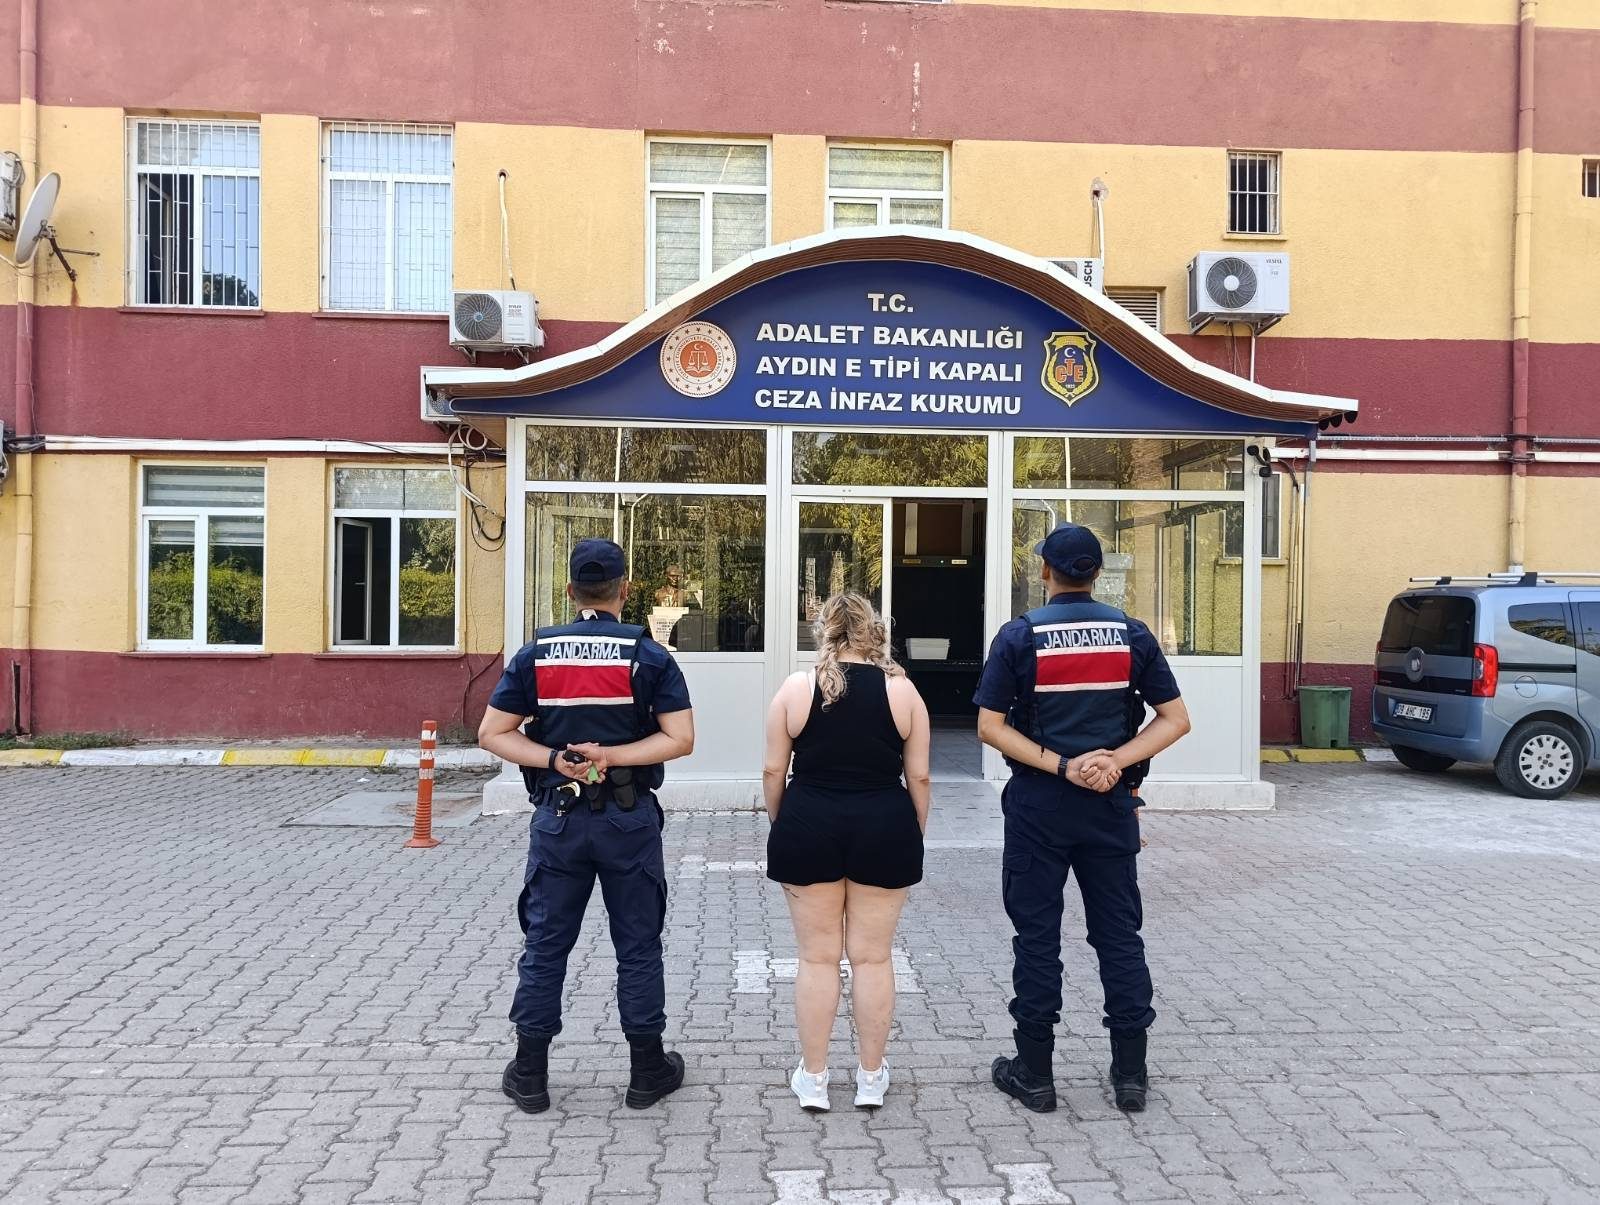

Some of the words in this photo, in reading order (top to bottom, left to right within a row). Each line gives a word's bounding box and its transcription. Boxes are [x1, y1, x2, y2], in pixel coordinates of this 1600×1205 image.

[867, 293, 914, 312] T.C.
[756, 323, 864, 344] ADALET
[873, 326, 1023, 349] BAKANLIĞI
[756, 356, 837, 377] AYDIN
[845, 359, 861, 377] E
[870, 355, 920, 379] TİPİ
[929, 361, 1022, 382] KAPALI
[755, 389, 822, 409] CEZA
[830, 387, 903, 411] İNFAZ
[911, 394, 1021, 415] KURUMU
[1044, 628, 1124, 649] JANDARMA
[545, 642, 621, 660] JANDARMA
